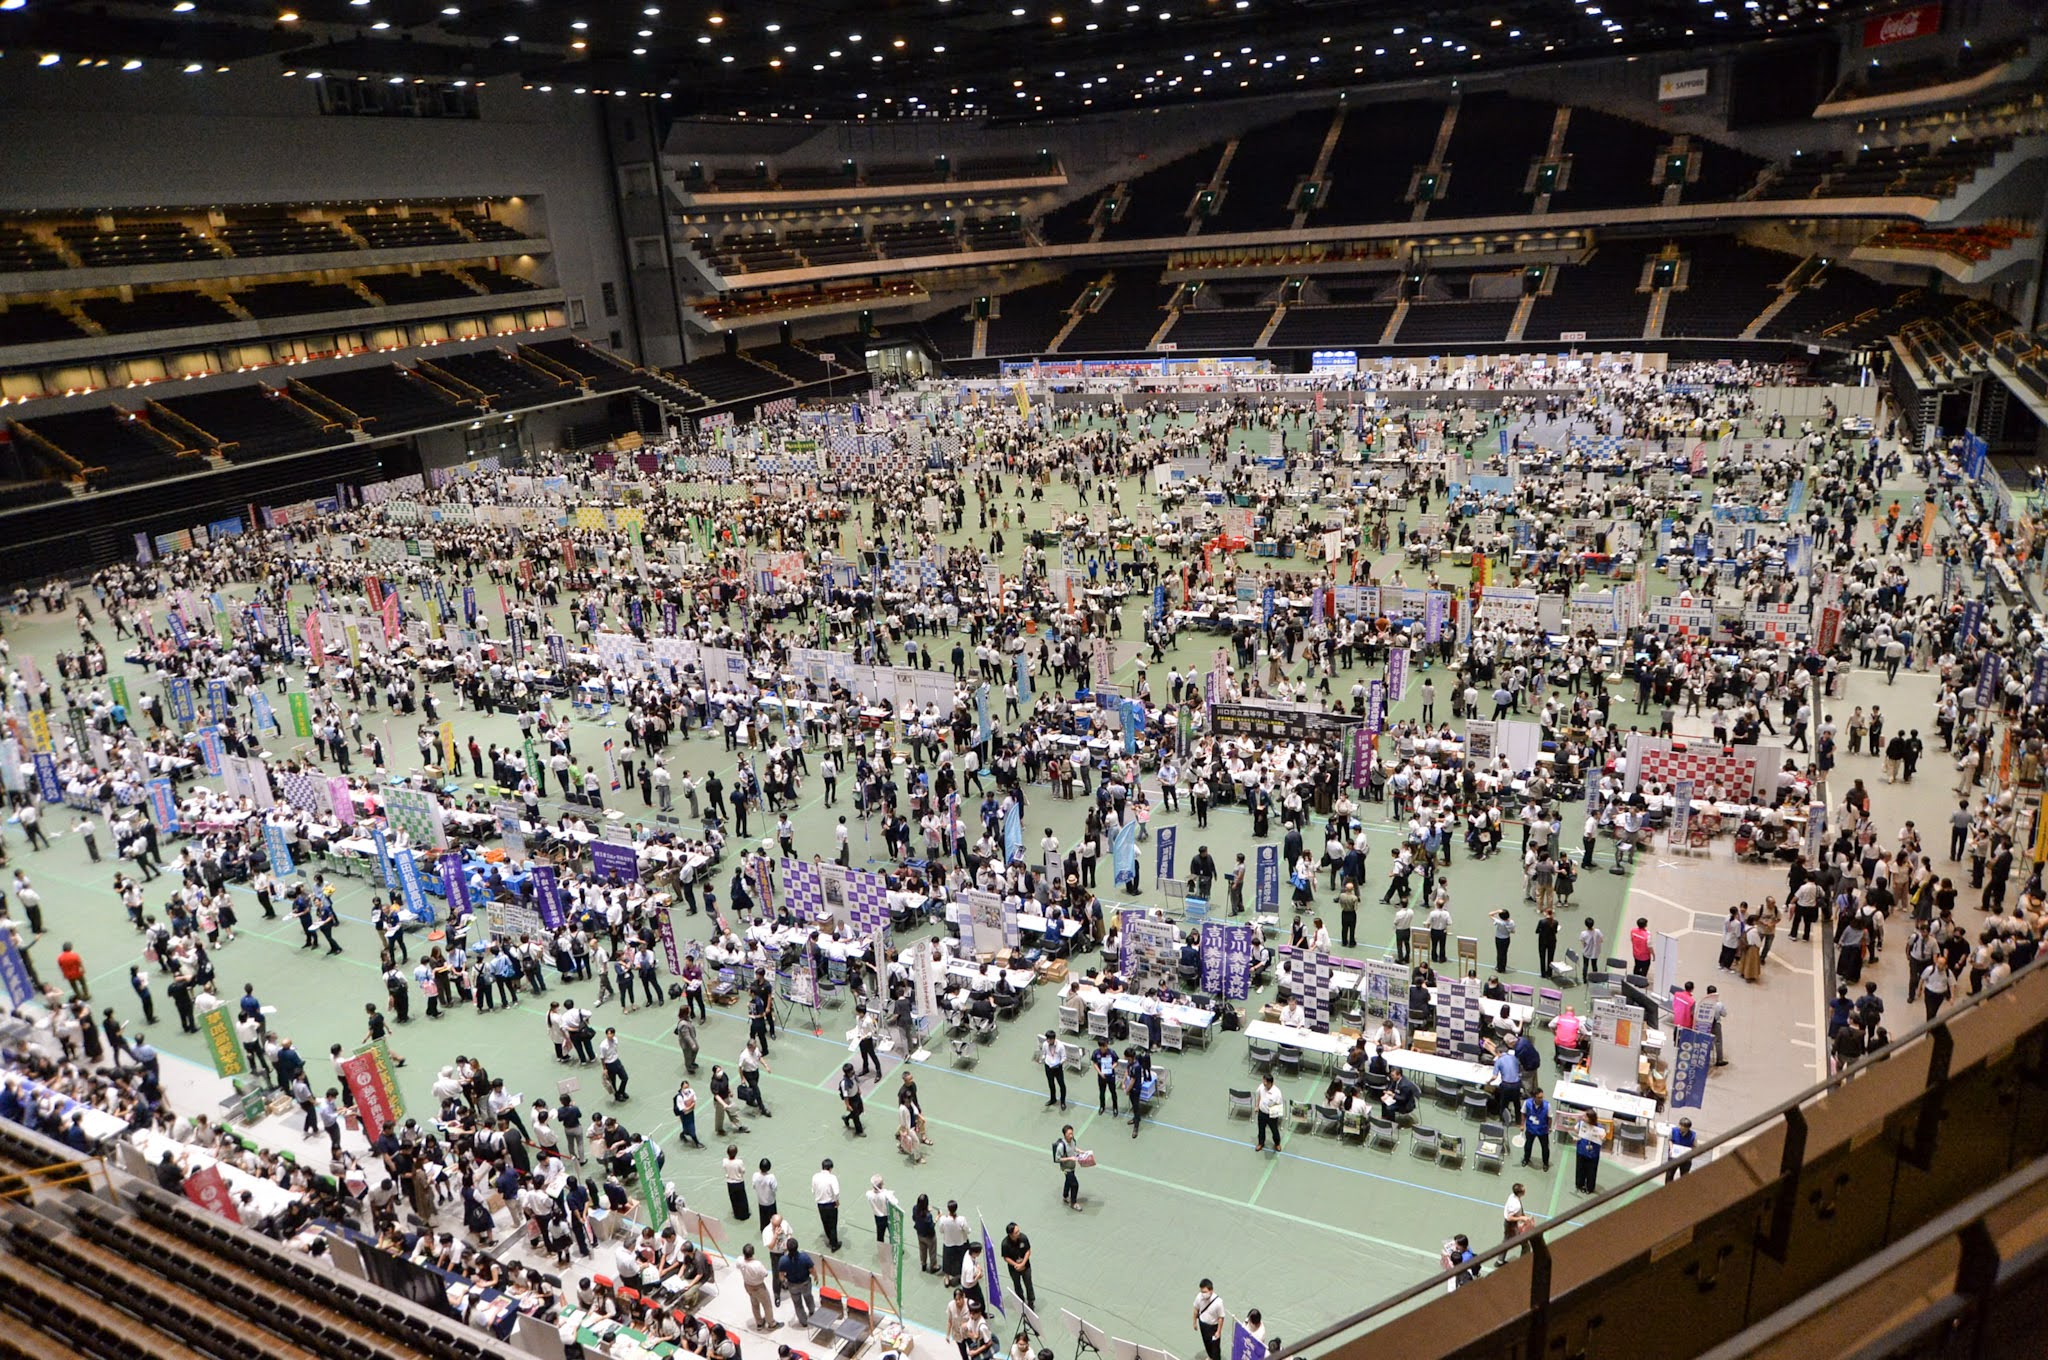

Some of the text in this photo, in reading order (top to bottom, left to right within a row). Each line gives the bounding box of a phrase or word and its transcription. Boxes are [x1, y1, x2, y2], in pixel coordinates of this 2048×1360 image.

[1676, 79, 1704, 90] SAPPORO
[1217, 708, 1270, 719] 川口市立高等学校
[661, 926, 679, 974] 松山高校
[1205, 925, 1222, 992] 吉川美南高校
[1228, 928, 1247, 999] 吉川美南高校
